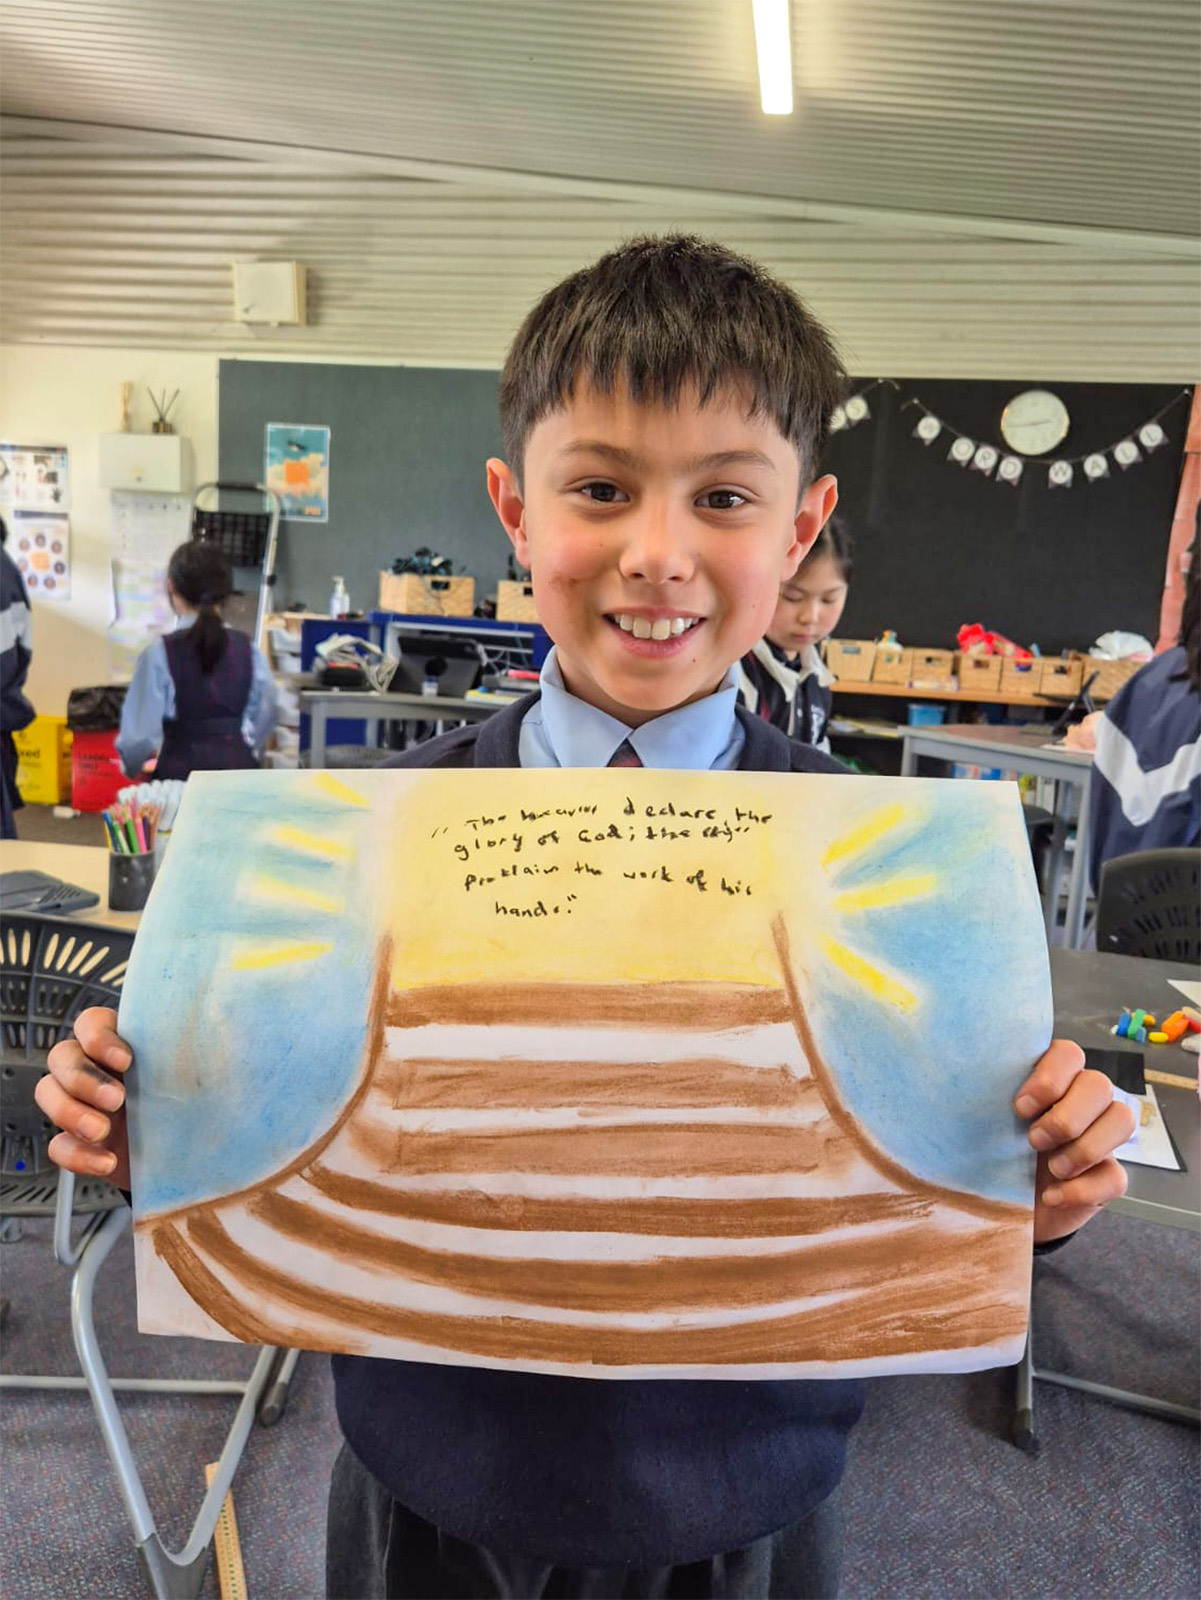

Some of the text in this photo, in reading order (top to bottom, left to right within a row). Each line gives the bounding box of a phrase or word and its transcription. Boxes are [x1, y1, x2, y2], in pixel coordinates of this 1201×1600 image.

[1052, 429, 1160, 478] WALL
[454, 833, 523, 861] glory
[537, 830, 560, 846] of
[623, 865, 674, 883] work
[686, 869, 708, 892] of
[720, 877, 753, 896] his
